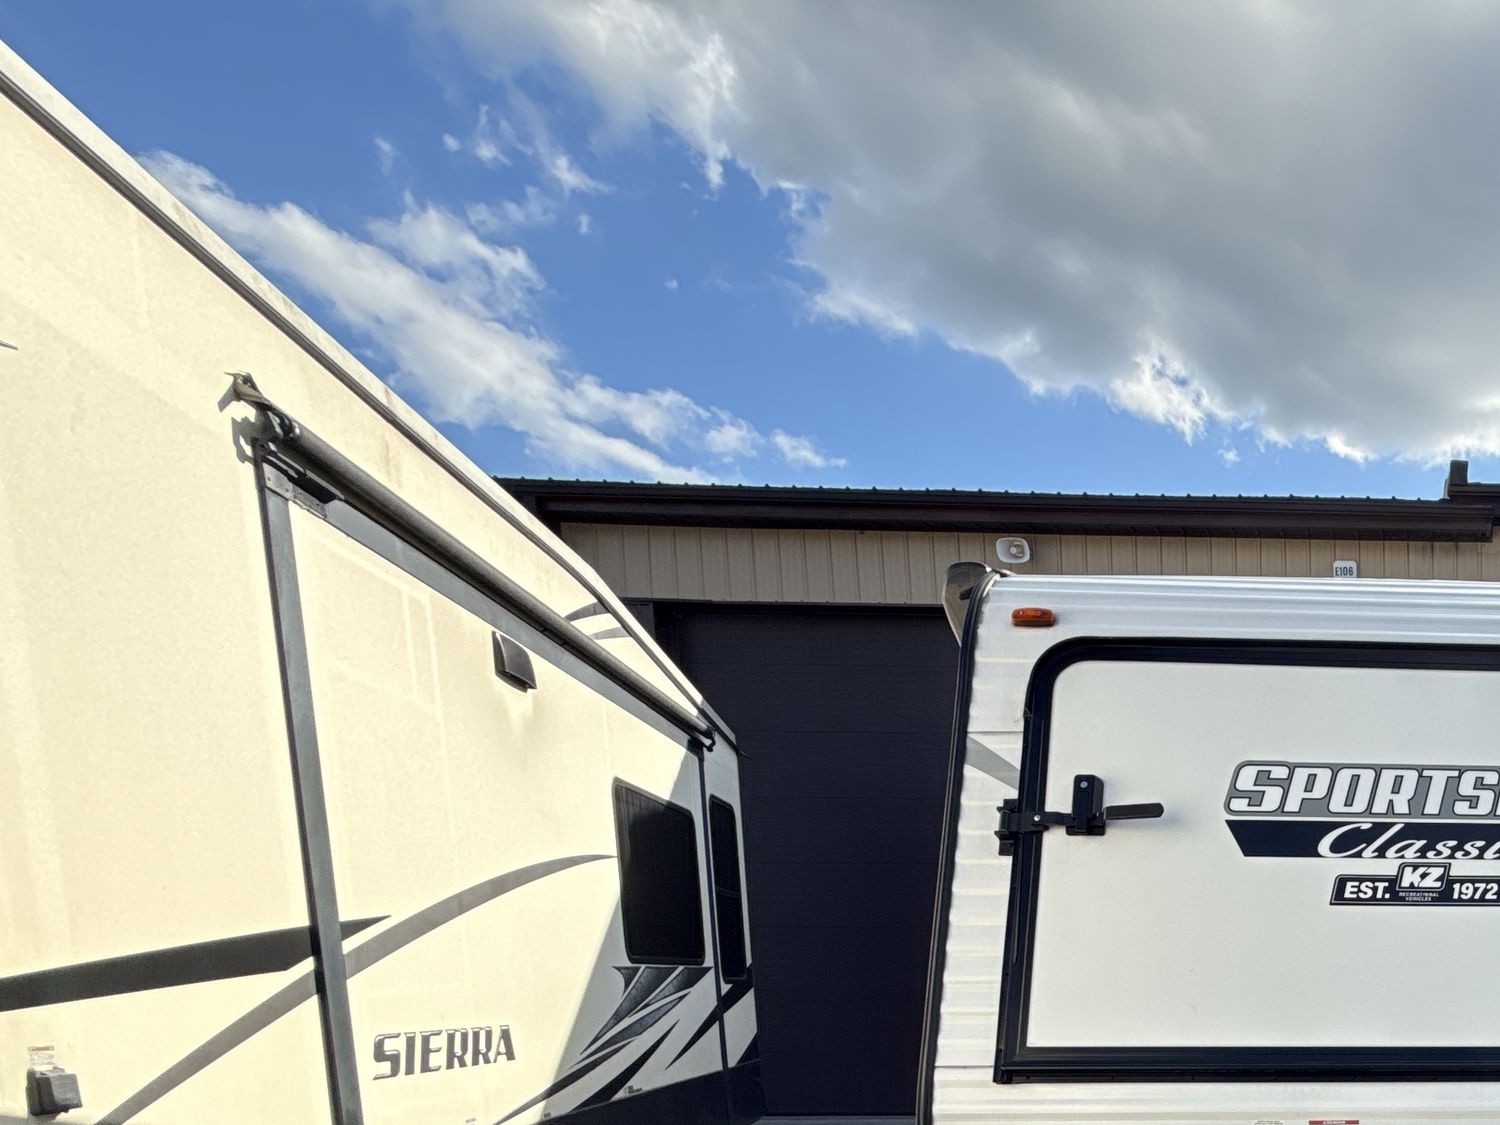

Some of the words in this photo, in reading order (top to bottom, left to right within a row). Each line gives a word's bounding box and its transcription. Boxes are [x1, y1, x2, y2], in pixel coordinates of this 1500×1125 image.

[1335, 566, 1354, 577] E106
[1401, 867, 1445, 888] KZ
[1343, 881, 1391, 899] EST.
[1452, 882, 1499, 900] 1972
[372, 1024, 516, 1081] SIERRA
